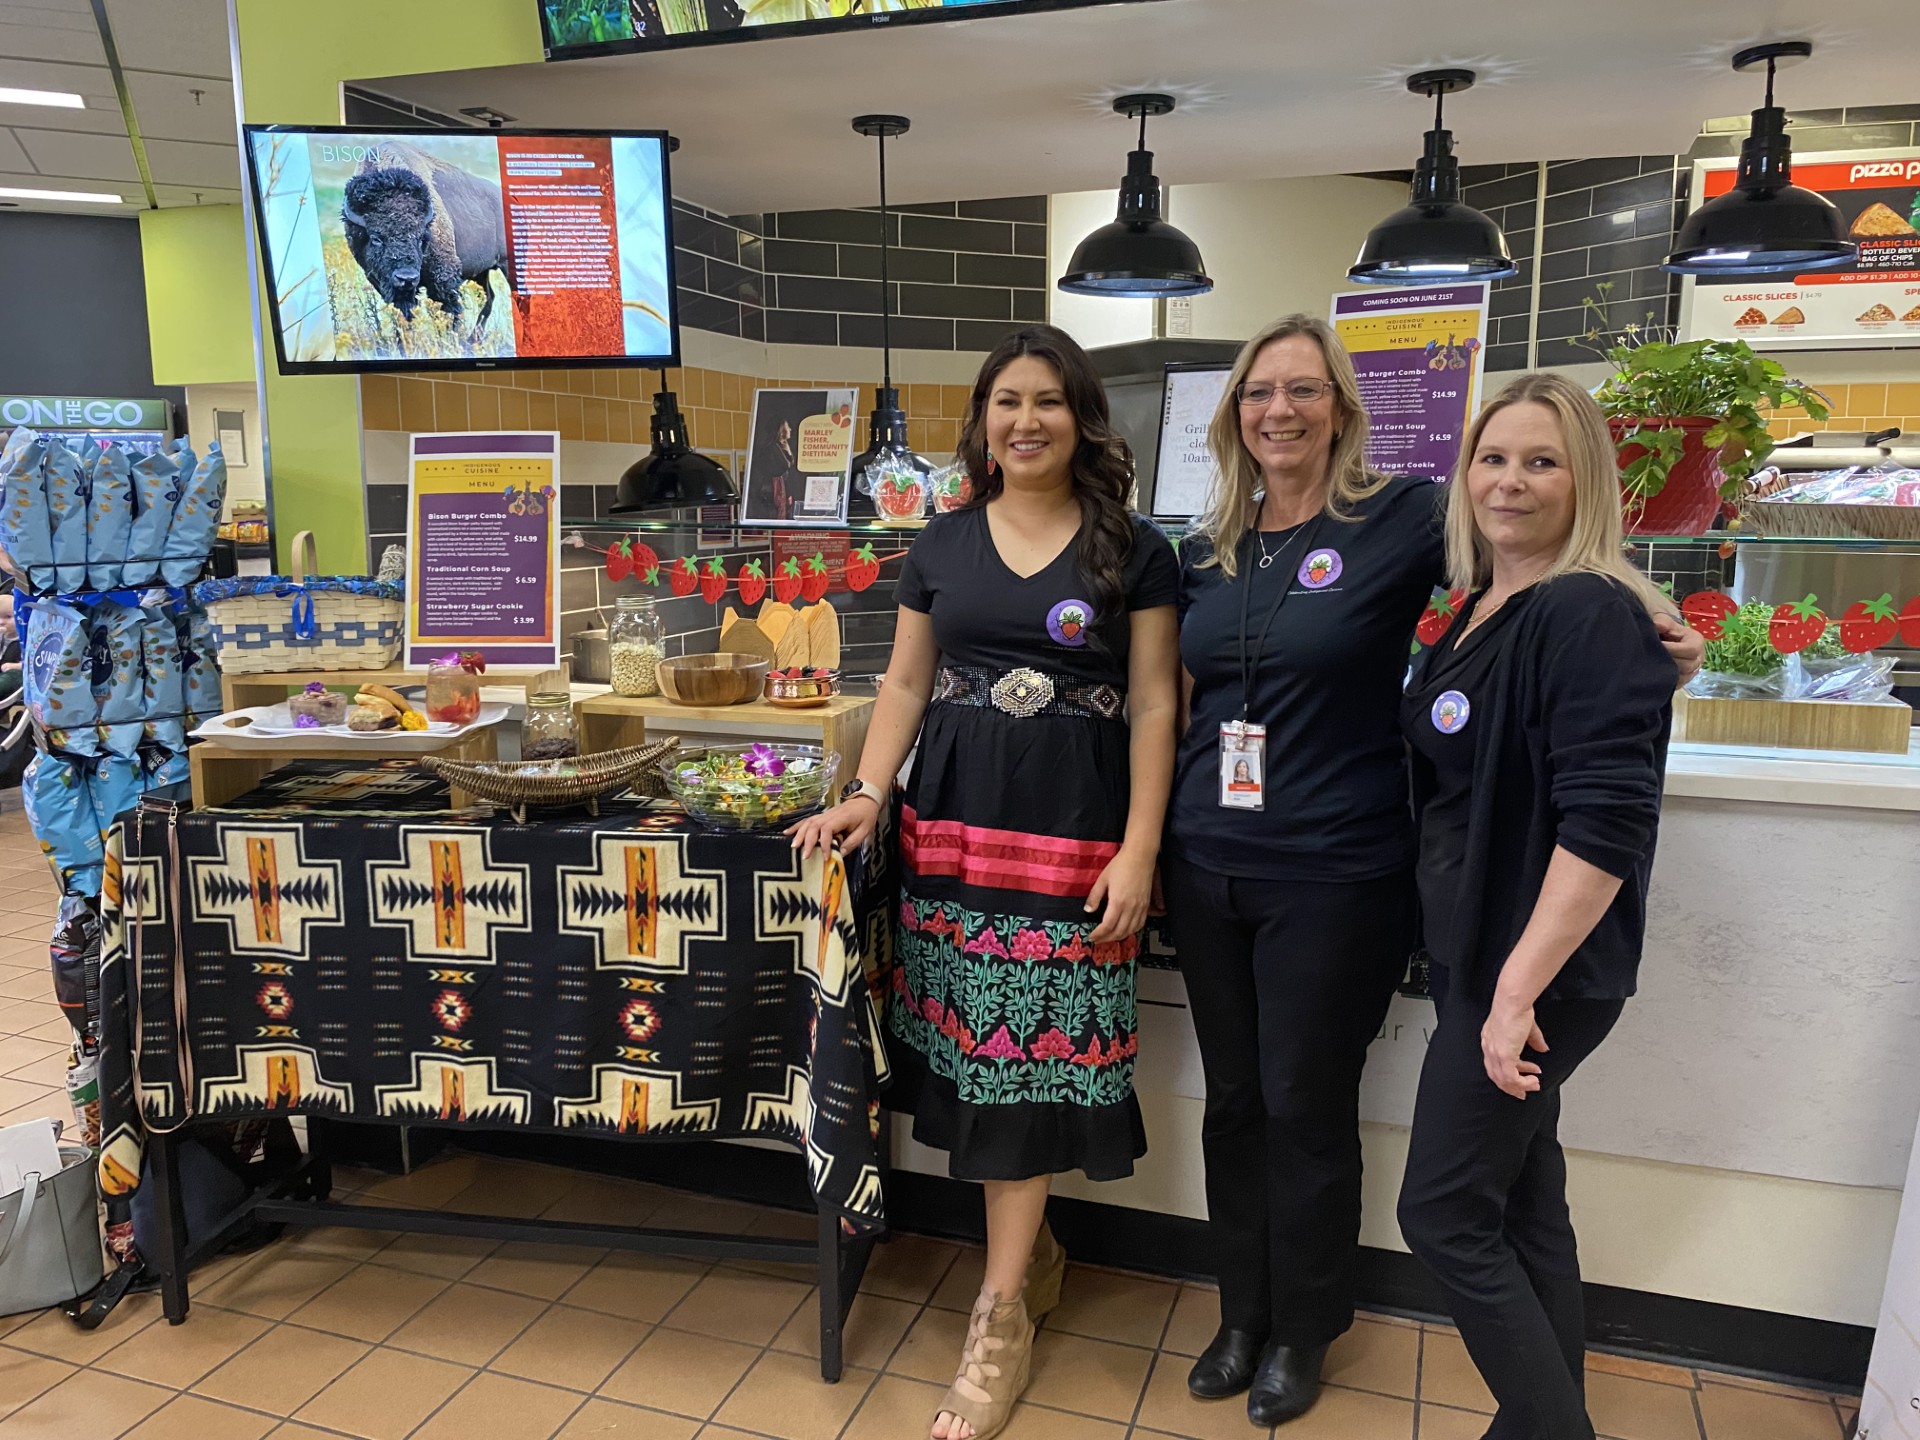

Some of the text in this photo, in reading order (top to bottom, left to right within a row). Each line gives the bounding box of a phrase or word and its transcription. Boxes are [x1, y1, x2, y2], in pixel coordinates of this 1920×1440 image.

[322, 146, 380, 162] BISON
[1850, 163, 1904, 183] pizza
[1432, 391, 1456, 399] $14.99
[2, 399, 143, 426] ON THE GO
[1165, 384, 1173, 425] GRILL
[1183, 453, 1211, 463] 10am
